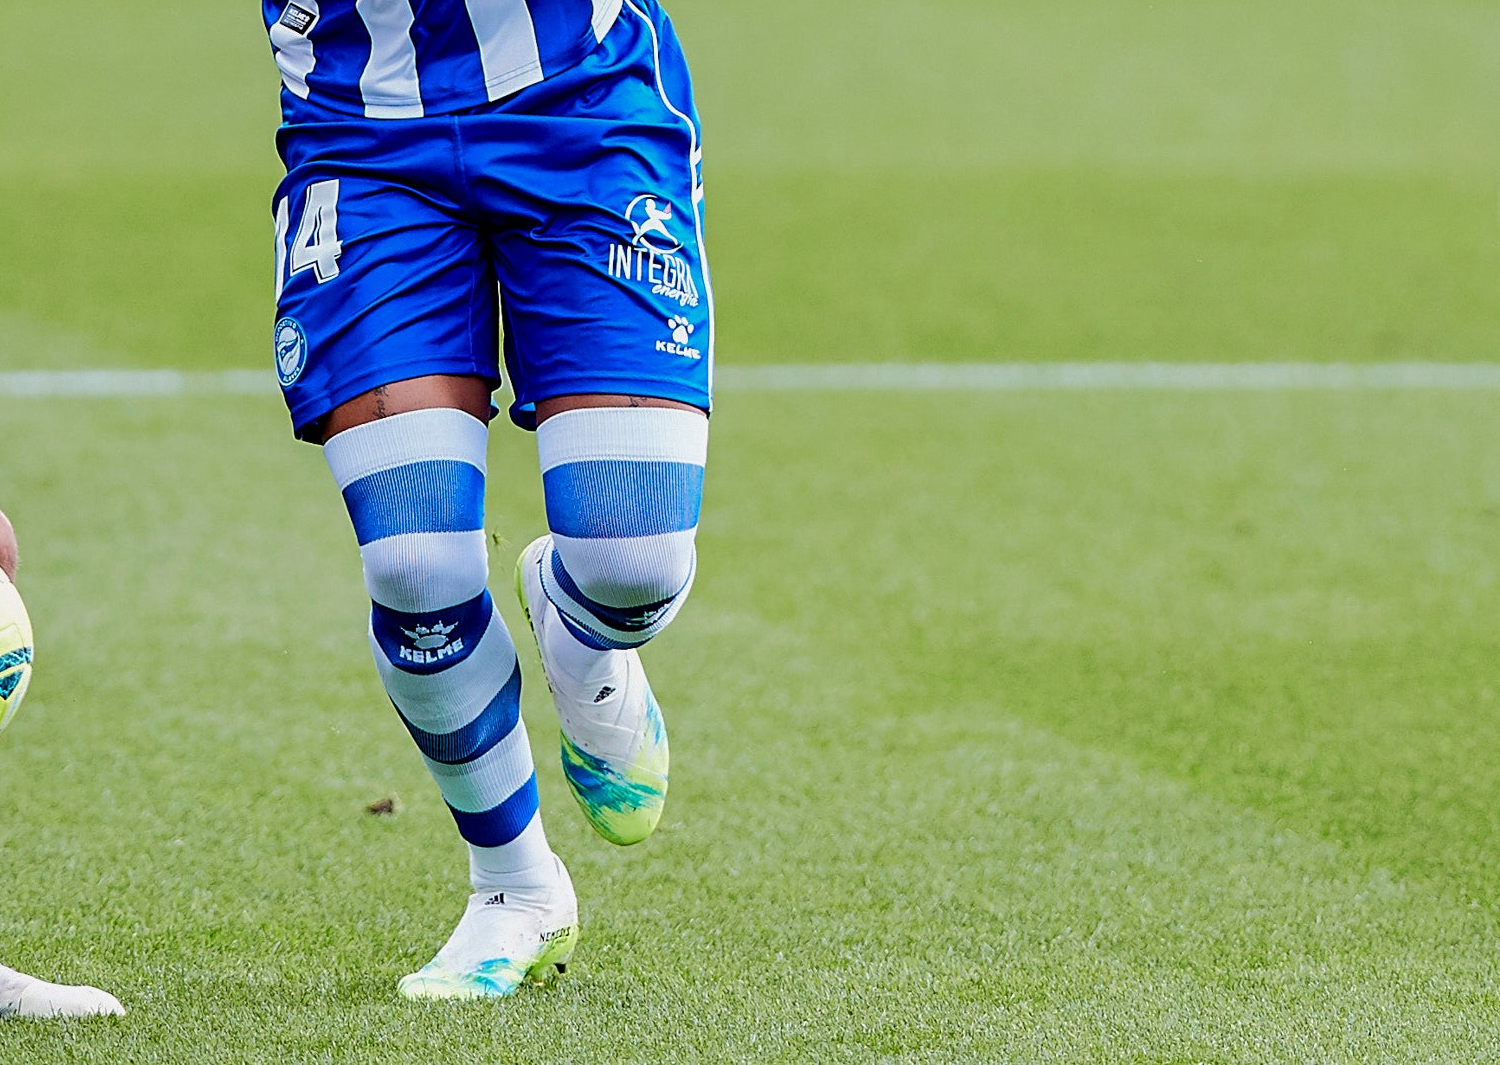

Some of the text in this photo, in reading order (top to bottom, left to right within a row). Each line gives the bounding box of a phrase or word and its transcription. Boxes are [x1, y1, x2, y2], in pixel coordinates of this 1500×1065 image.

[274, 178, 343, 304] 14
[608, 243, 699, 298] INTEGRA
[655, 340, 701, 360] KELME
[399, 637, 464, 664] KELME
